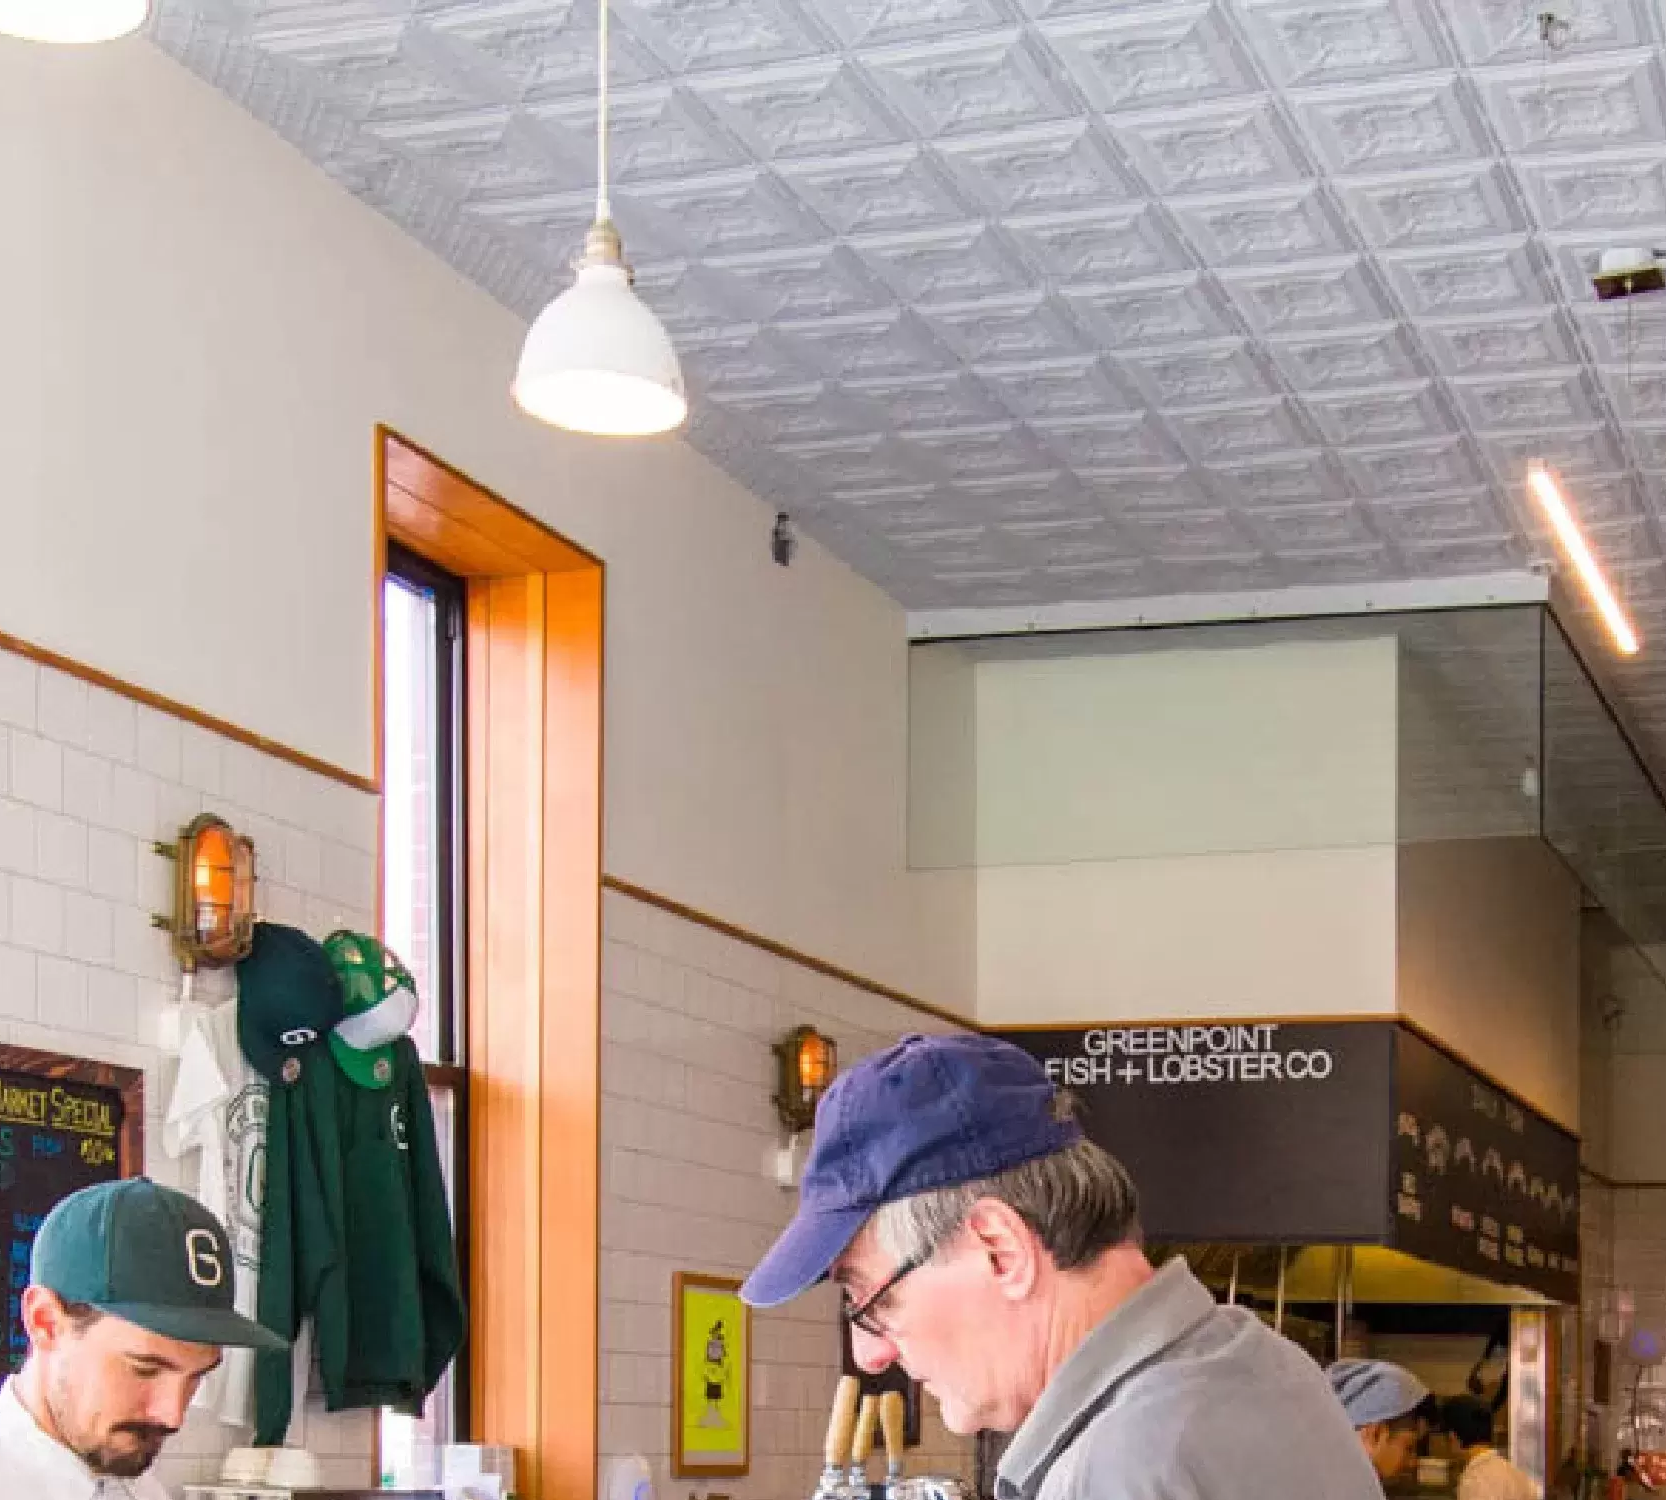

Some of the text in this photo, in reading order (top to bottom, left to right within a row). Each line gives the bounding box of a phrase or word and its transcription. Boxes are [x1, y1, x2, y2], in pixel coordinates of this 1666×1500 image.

[1084, 1023, 1279, 1055] GREENPOINT
[1044, 1057, 1111, 1085] FISH
[1146, 1052, 1283, 1084] LOBSTER
[1285, 1050, 1333, 1079] CO
